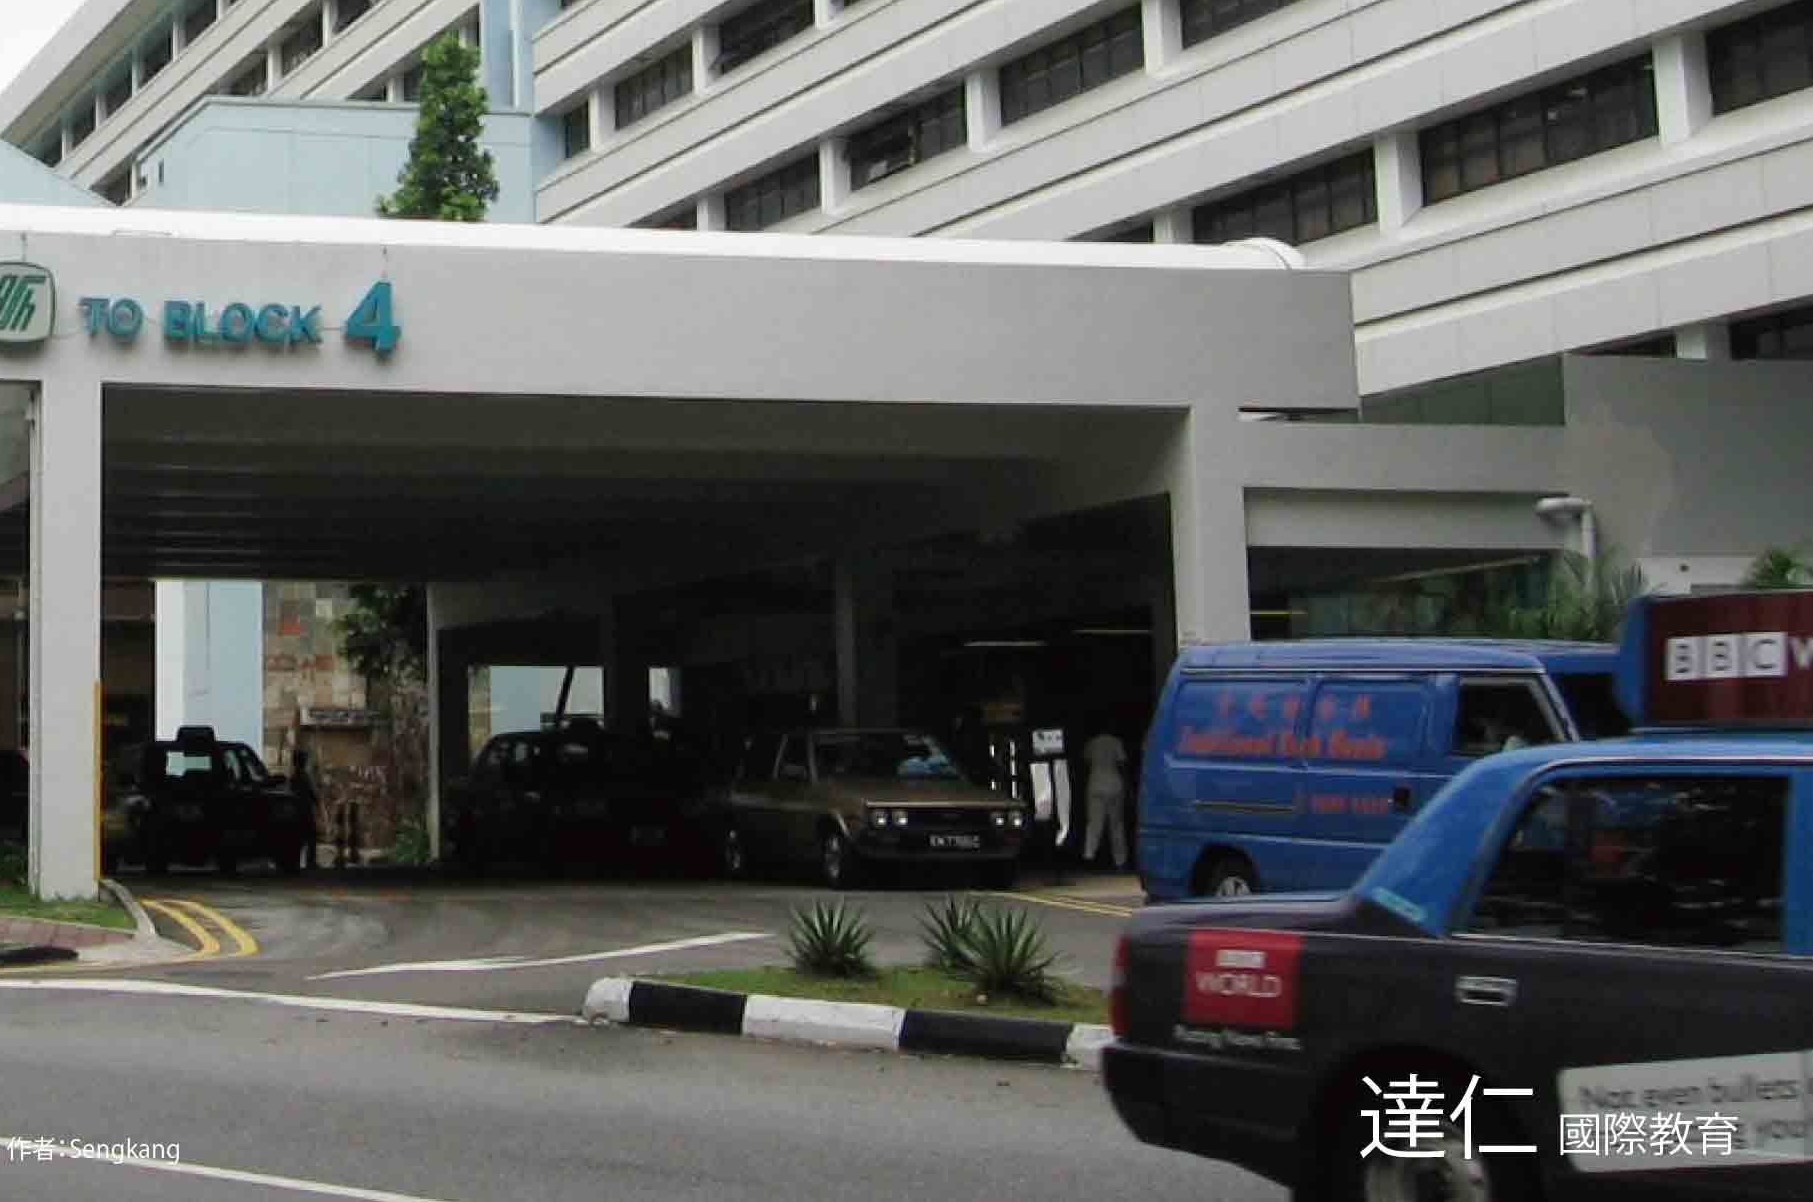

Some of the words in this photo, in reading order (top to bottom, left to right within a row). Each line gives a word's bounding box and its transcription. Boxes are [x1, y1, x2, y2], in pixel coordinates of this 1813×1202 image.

[80, 297, 143, 336] TO
[162, 299, 323, 345] BLOCK
[345, 279, 401, 353] 4
[1666, 631, 1788, 682] BBC
[1195, 972, 1283, 999] WORLD
